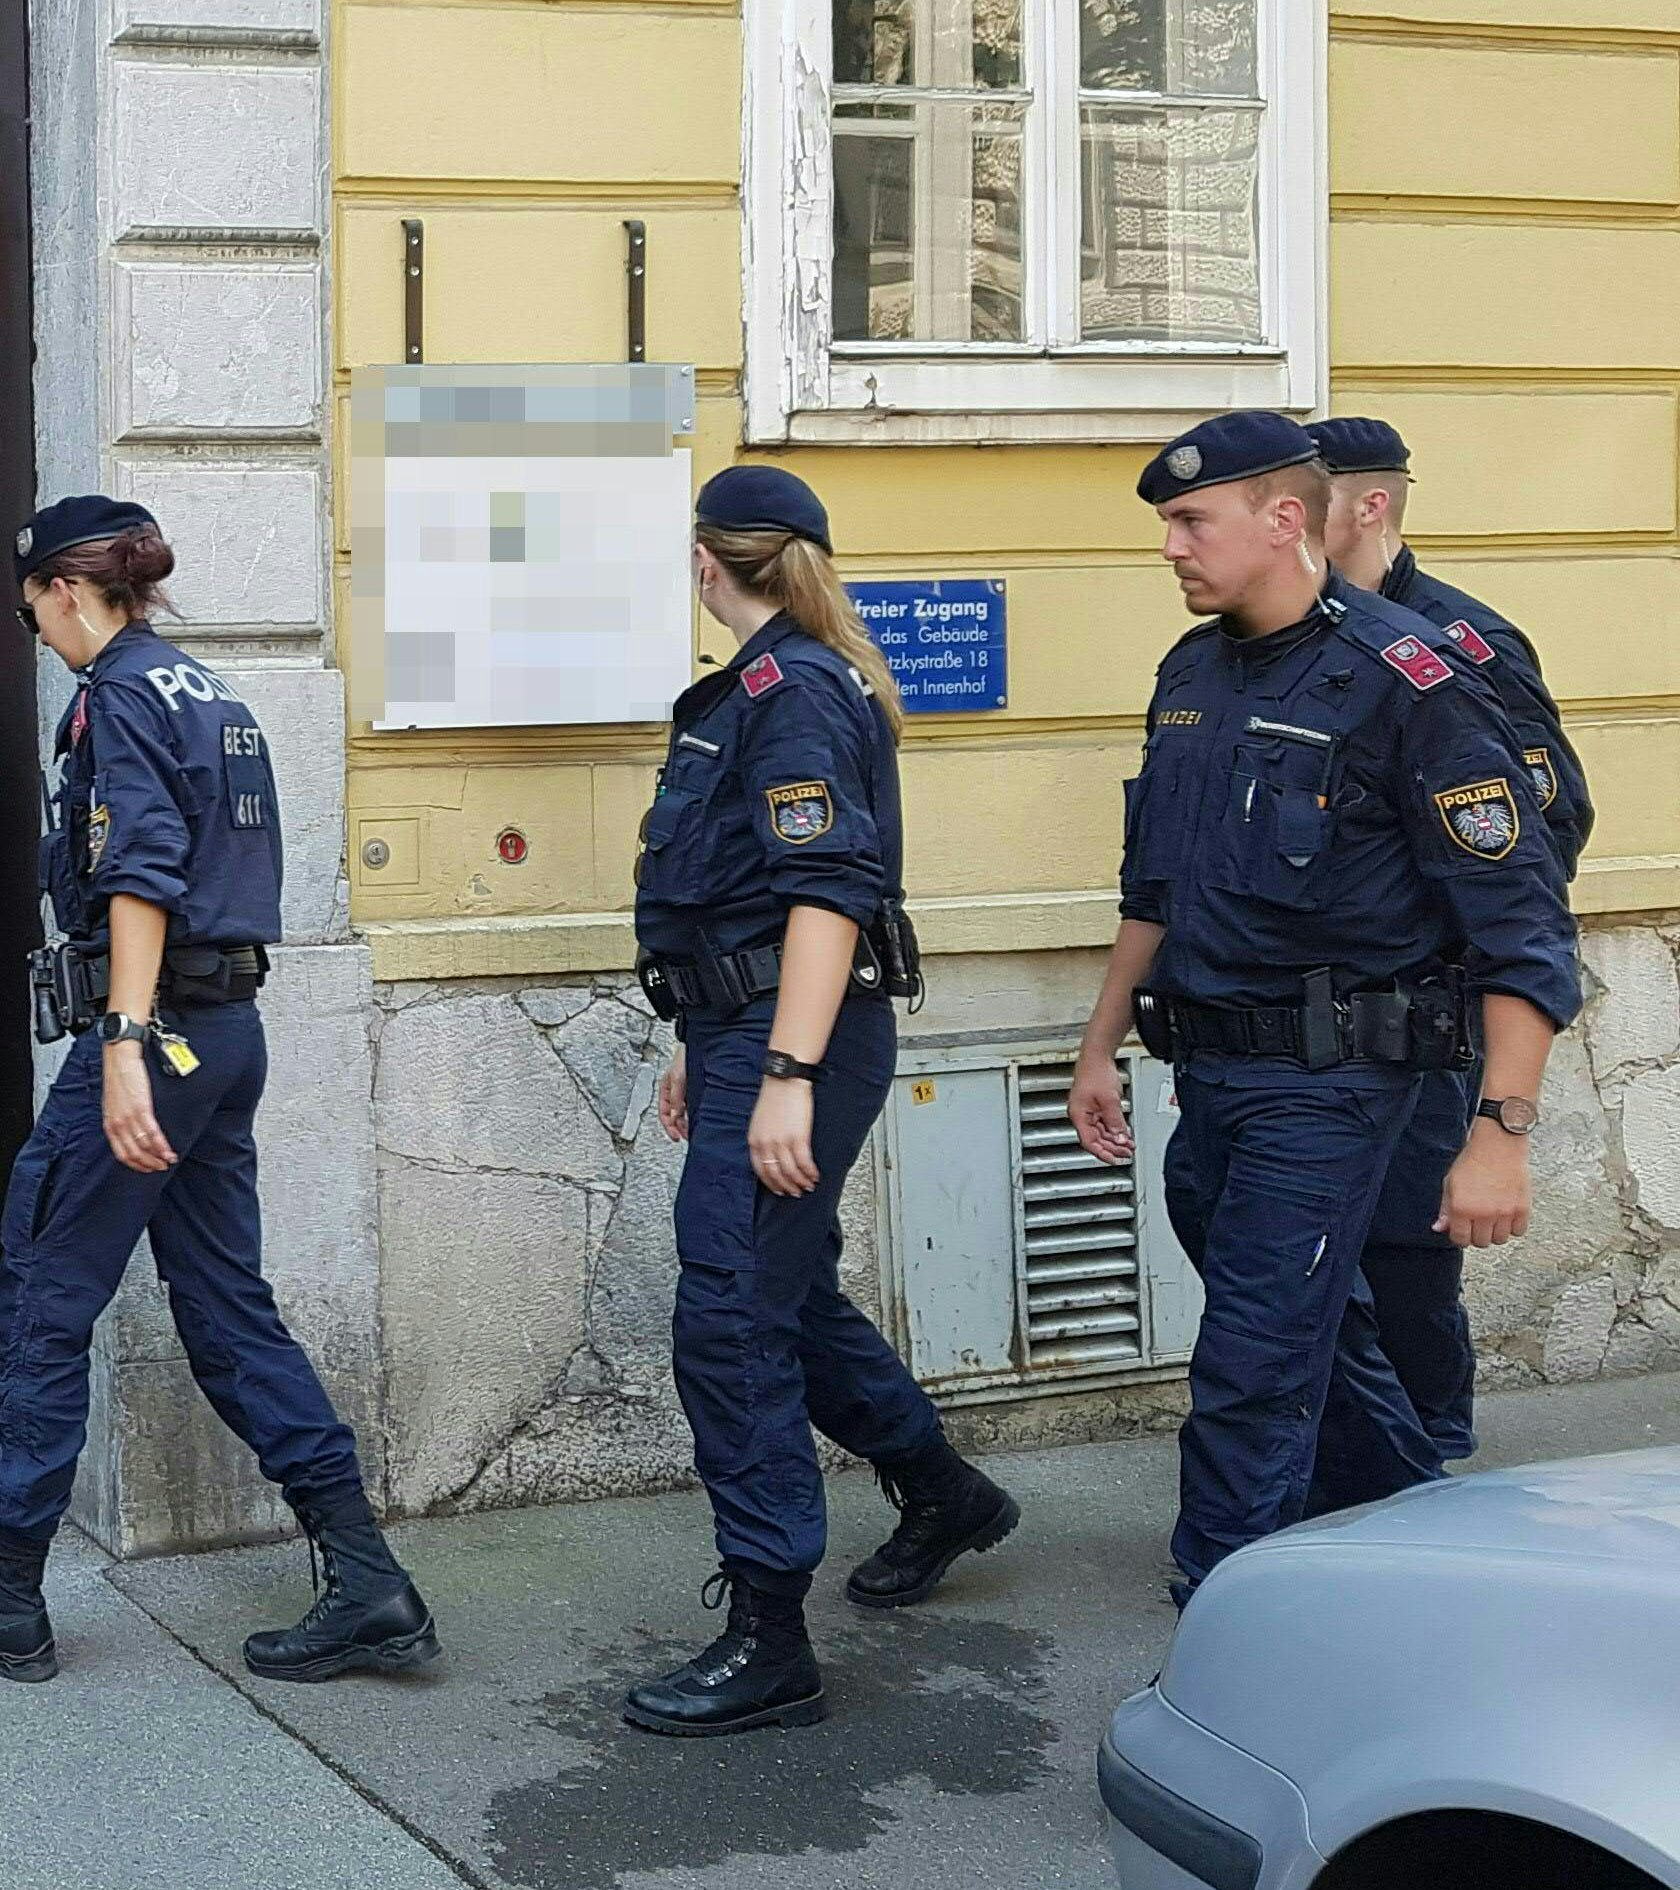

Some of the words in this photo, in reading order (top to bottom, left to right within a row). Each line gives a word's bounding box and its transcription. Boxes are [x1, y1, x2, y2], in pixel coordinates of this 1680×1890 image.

[853, 598, 908, 618] freier
[914, 599, 988, 621] Zugang
[880, 626, 908, 645] das
[918, 624, 988, 643] Gebäude
[888, 650, 963, 675] tzkystraße
[970, 651, 988, 668] 18
[923, 675, 986, 695] Innenhof
[1442, 784, 1504, 809] POLIZEI
[237, 793, 262, 825] 611
